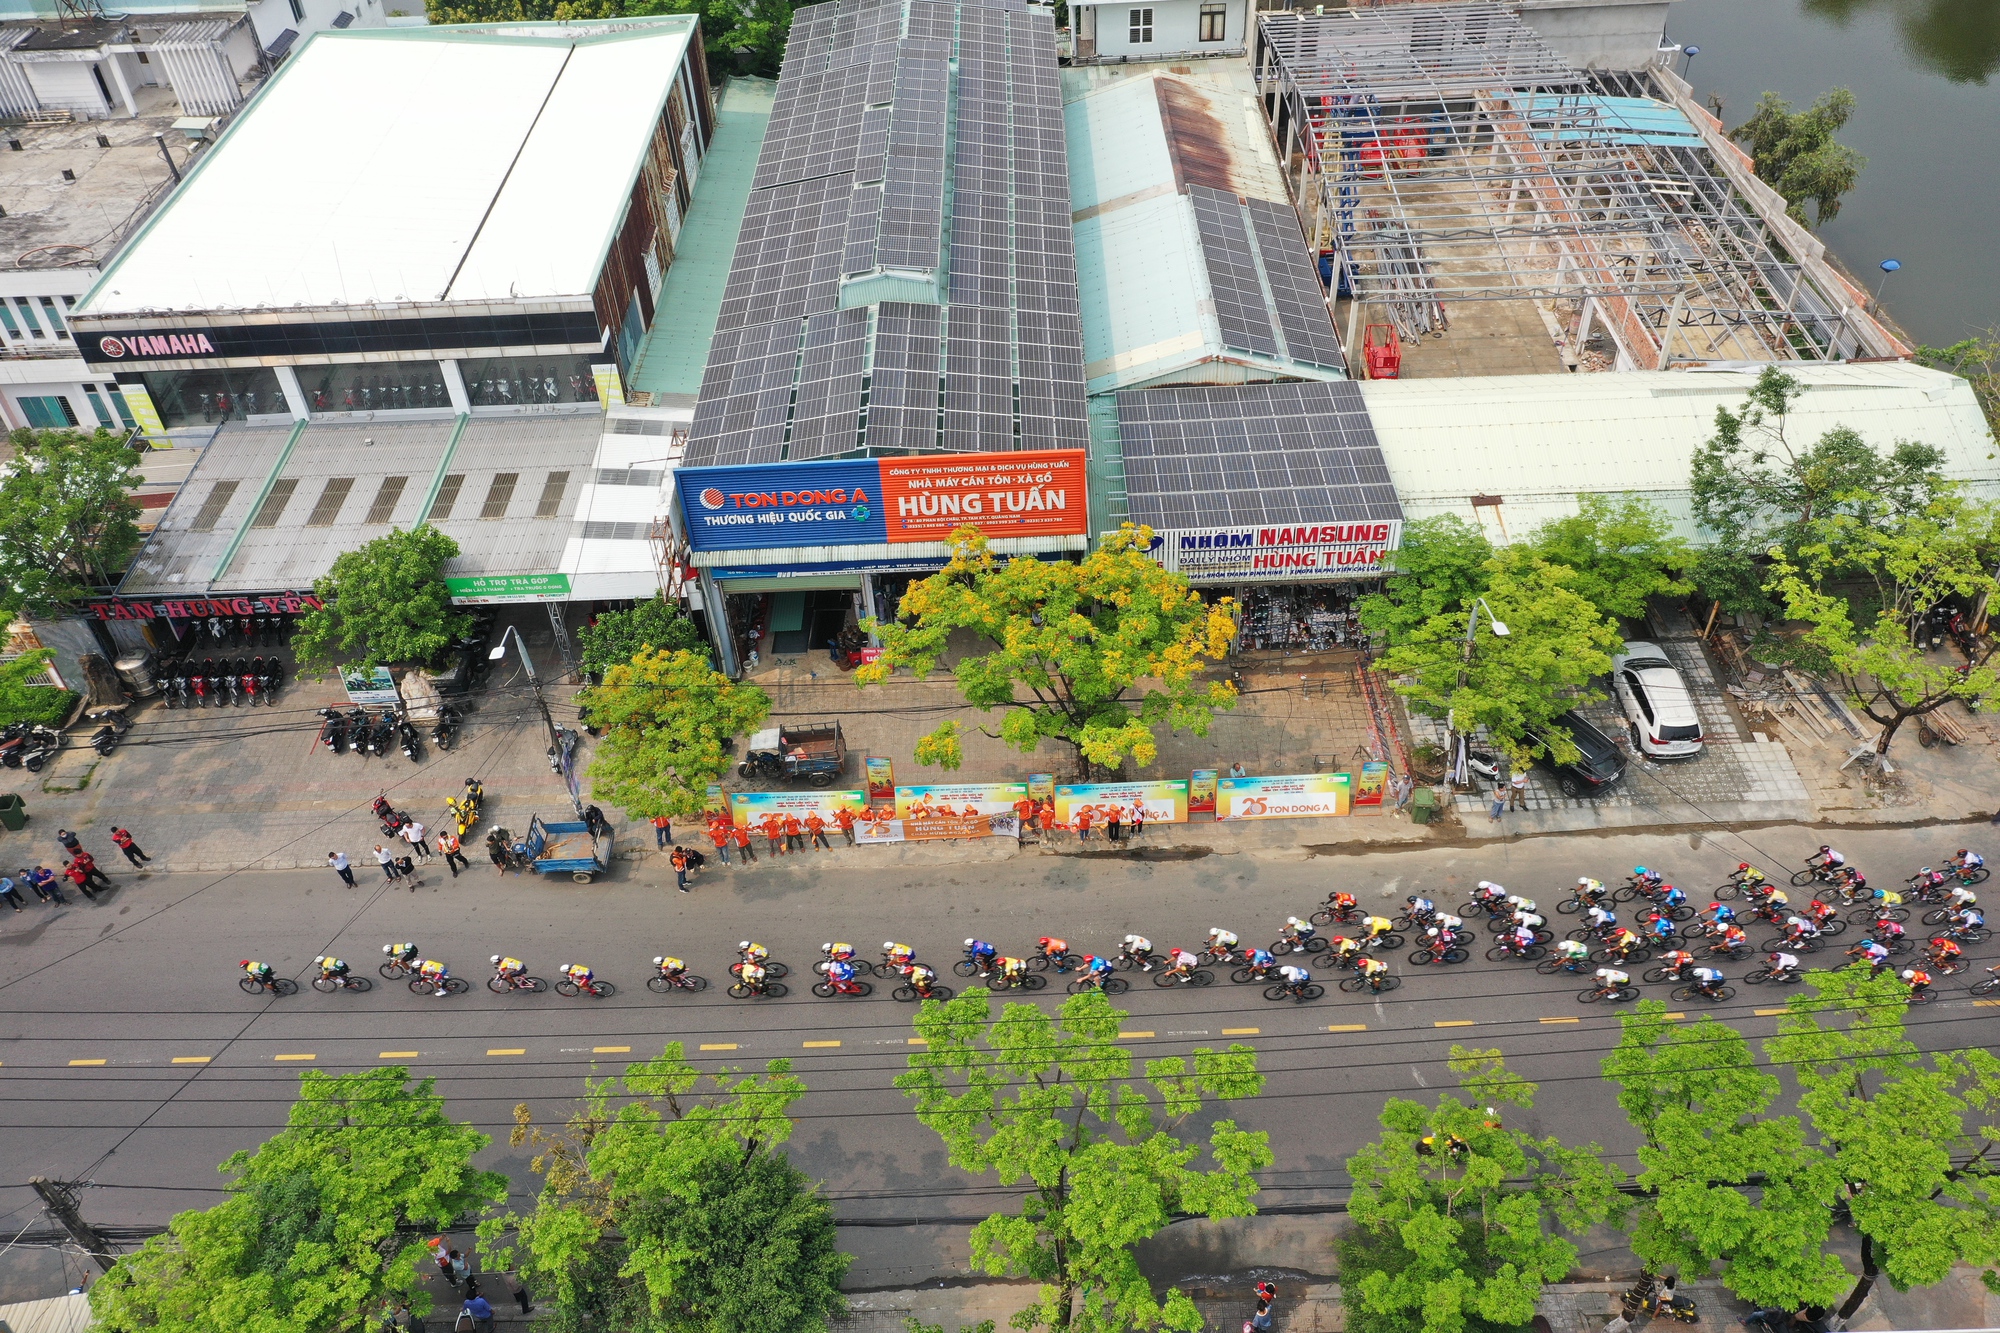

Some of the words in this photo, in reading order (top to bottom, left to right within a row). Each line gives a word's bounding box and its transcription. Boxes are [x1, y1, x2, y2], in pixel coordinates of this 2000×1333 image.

[122, 334, 214, 356] YAMAHA
[889, 468, 910, 476] CÔNG
[943, 465, 974, 474] THƯƠNG
[975, 465, 990, 473] MẠI
[998, 464, 1015, 472] DỊCH
[1016, 464, 1027, 472] VỤ
[1028, 462, 1048, 470] HÙNG
[1050, 460, 1070, 468] TUẤN
[908, 476, 932, 489] NHÀ
[936, 476, 958, 488] MÁY
[961, 476, 984, 486] CÁN
[988, 474, 1011, 485] TÔN
[1018, 472, 1034, 484] XÀ
[729, 492, 778, 509] TON
[781, 488, 848, 506] DONG
[852, 488, 869, 502] A
[898, 492, 982, 516] HÙNG
[988, 484, 1066, 513] TUẤN
[704, 514, 754, 526] THƯƠNG
[758, 512, 784, 526] HIỆU
[788, 508, 822, 522] QUỐC
[825, 510, 846, 520] GIA
[1180, 531, 1252, 550] NHÔM
[1259, 524, 1389, 546] NAMSUNG
[1253, 550, 1316, 569] HÙNG
[1322, 546, 1386, 566] TUẤN
[88, 596, 156, 620] TÂN
[1242, 798, 1268, 815] 25
[1269, 805, 1289, 814] TON
[1291, 804, 1321, 813] DONG
